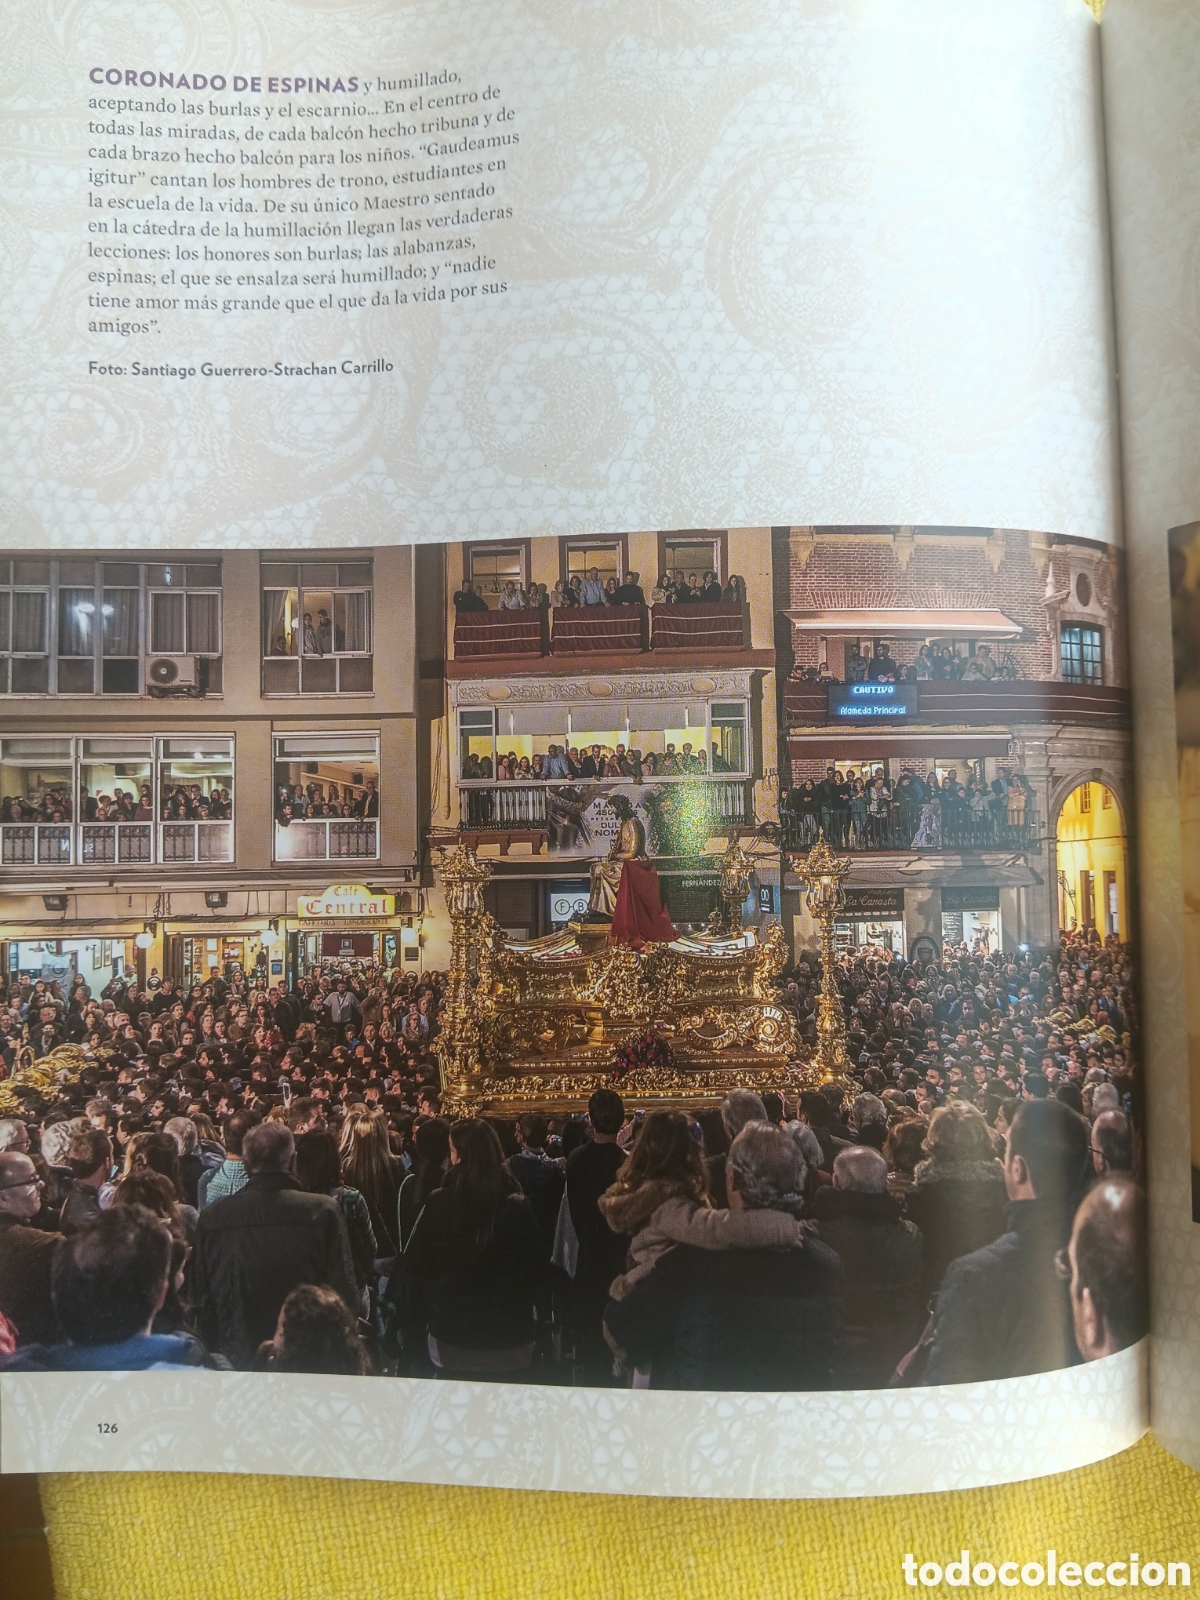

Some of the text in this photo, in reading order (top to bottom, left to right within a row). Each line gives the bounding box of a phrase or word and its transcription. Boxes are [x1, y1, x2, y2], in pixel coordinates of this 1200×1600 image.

[89, 68, 461, 95] CORONADO DE ESPINAS y humillado,
[89, 85, 500, 120] aceptando las burlas y el escarnio... En el centro de
[89, 107, 515, 142] todas las miradas, de cada balcón hecho tribuna y de
[89, 134, 519, 168] cada brazo hecho balcón para los niños. “Gaudeamus
[89, 160, 505, 189] igitur” cantan los hombres de trono, estudiantes en
[89, 182, 495, 212] la escuela de la vida. De su único Maestro sentado
[88, 207, 512, 238] en la cátedra de la humillación llegan las verdaderas
[89, 238, 475, 261] lecciones: los honores son burlas; las alabanzas,
[88, 256, 495, 288] espinas; el que se ensalza será humillado; y “nadie
[89, 282, 507, 313] tiene amor más grande que el que da la vida por sus
[89, 318, 160, 336] amigos”.
[89, 358, 393, 379] Foto: Santiago Guerrero-Strachan Carrillo
[853, 686, 894, 694] CAUTIVO
[840, 706, 906, 715] Alameda Principal
[333, 885, 359, 897] Café
[859, 894, 898, 907] Canasta
[305, 899, 388, 915] Central
[97, 1423, 118, 1434] 126
